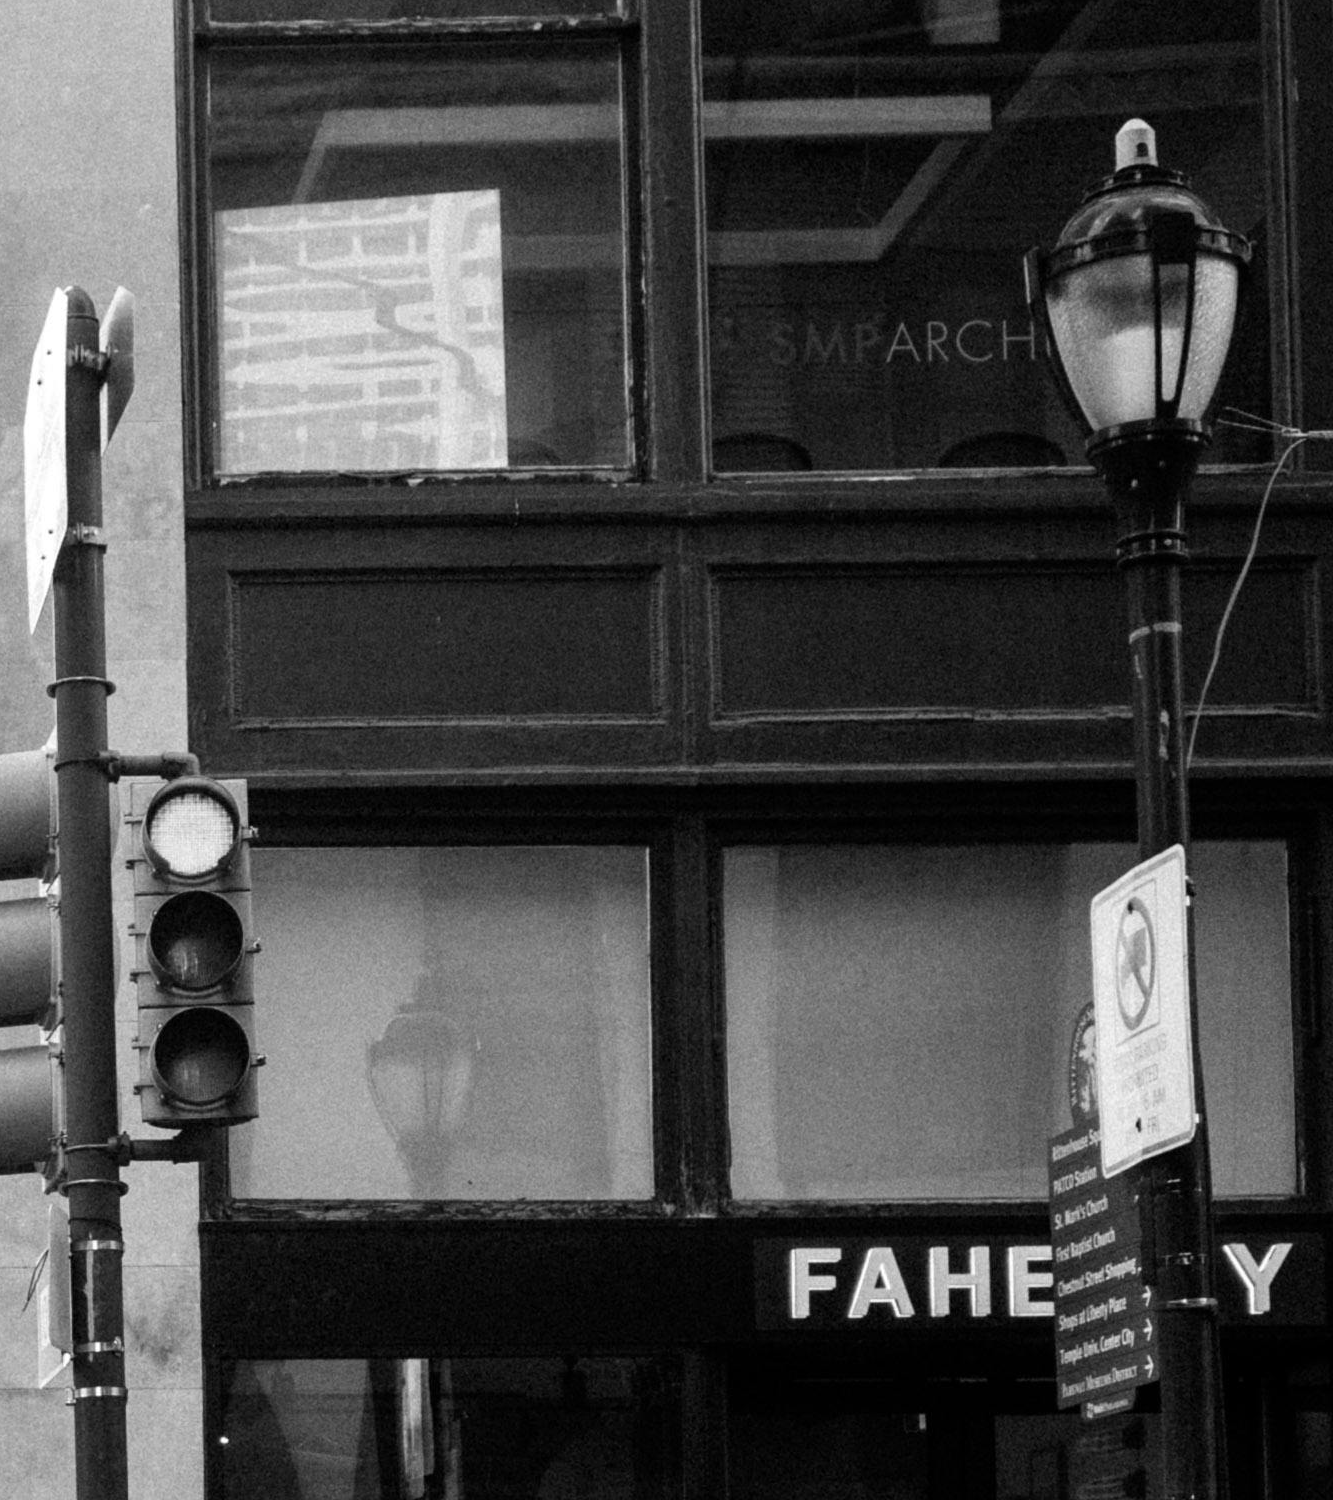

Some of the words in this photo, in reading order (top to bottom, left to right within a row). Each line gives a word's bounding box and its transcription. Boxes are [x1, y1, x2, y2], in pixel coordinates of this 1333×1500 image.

[1086, 1194, 1108, 1217] Church
[1093, 1227, 1116, 1249] Church
[789, 1243, 1294, 1318] FAHEY
